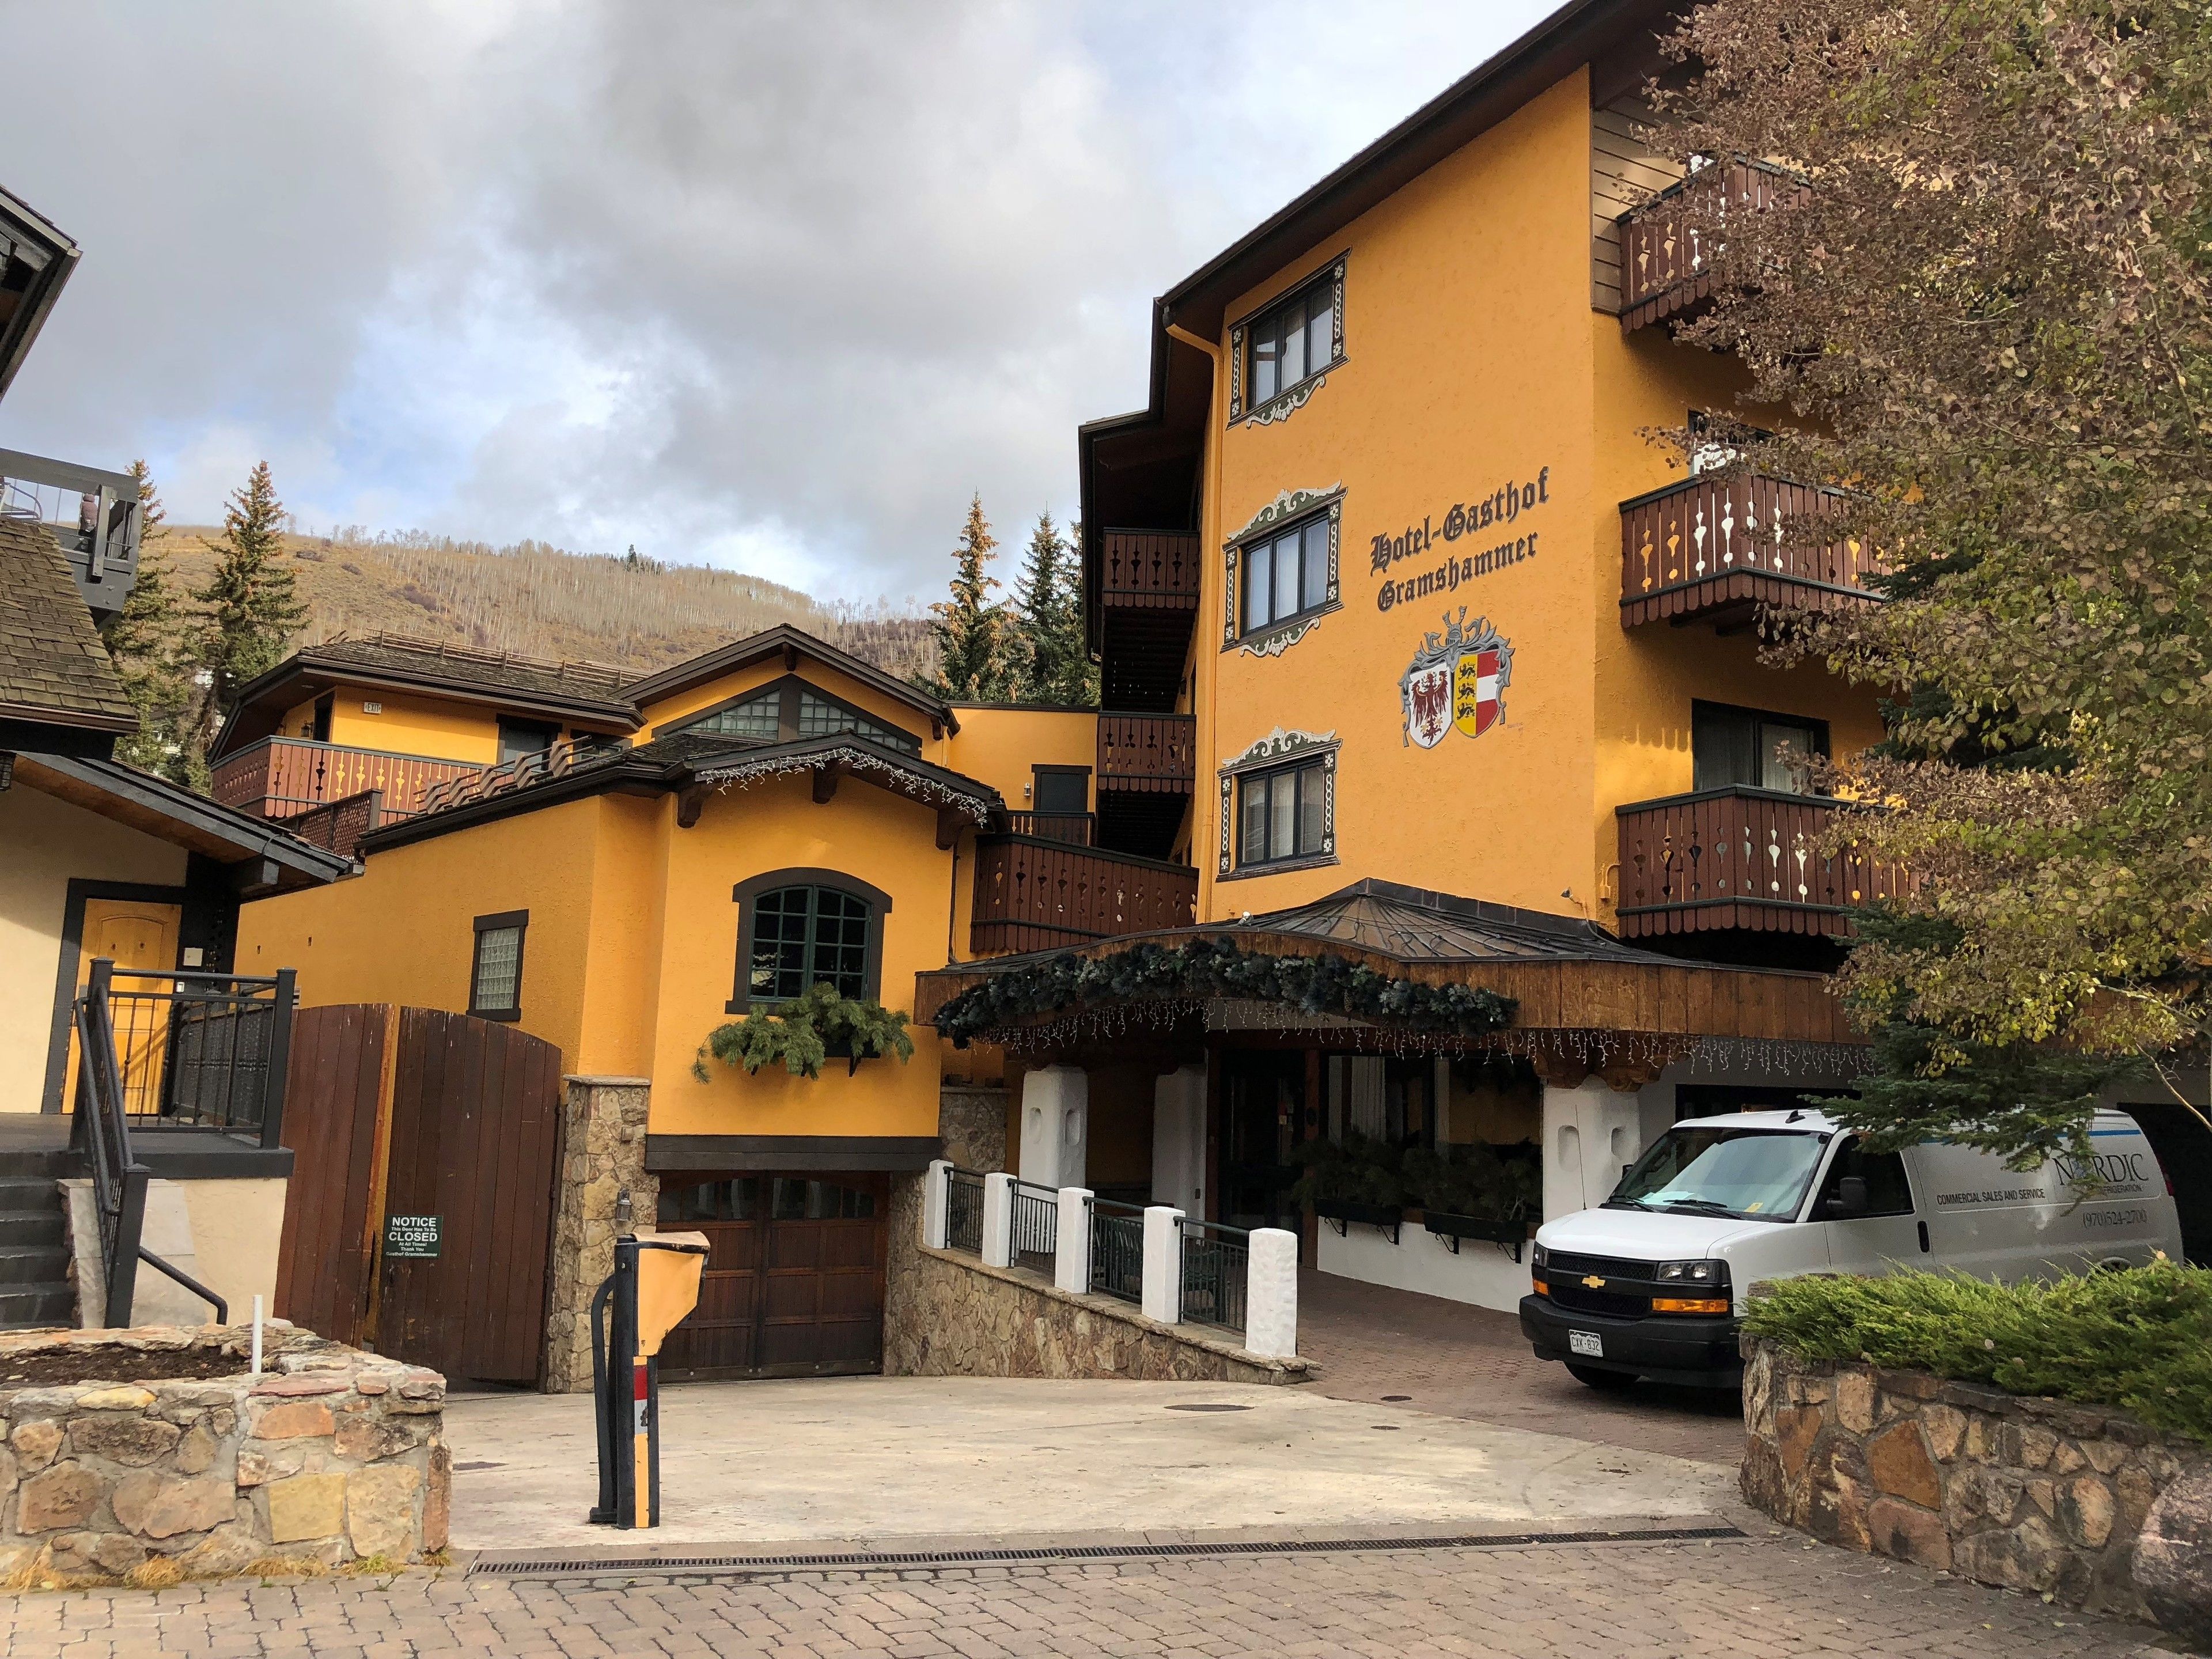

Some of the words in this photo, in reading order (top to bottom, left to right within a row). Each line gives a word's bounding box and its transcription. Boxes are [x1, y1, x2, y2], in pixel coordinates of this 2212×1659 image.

[1370, 466, 1550, 577] Hotel-Gasthof
[1377, 531, 1539, 612] Gramshammer
[368, 703, 380, 712] EXIT
[1937, 1192, 1982, 1205] COMMERCIAL
[1982, 1190, 2003, 1202] SALES
[2004, 1190, 2017, 1200] AND
[2018, 1188, 2046, 1200] SERVICE
[392, 1217, 437, 1227] NOTICE
[389, 1232, 438, 1242] CLOSED
